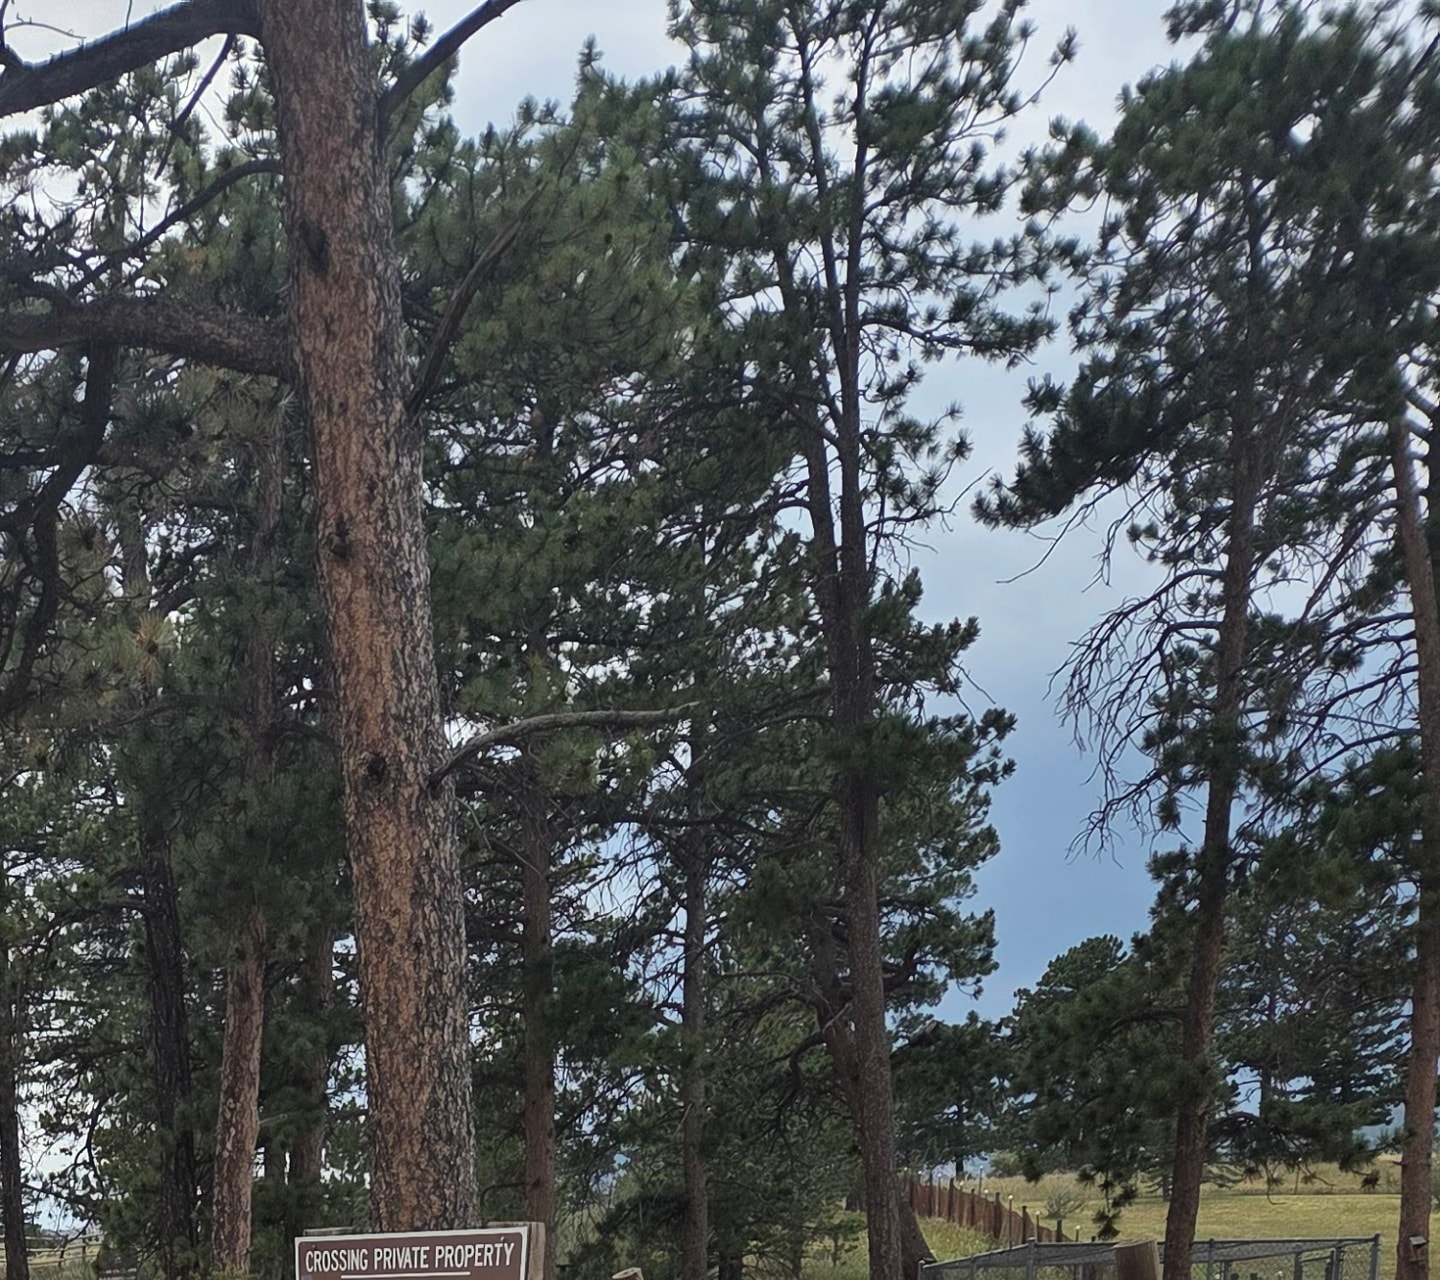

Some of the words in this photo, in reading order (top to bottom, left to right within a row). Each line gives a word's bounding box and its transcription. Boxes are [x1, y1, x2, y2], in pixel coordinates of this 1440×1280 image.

[305, 1248, 368, 1273] CROSSING
[374, 1246, 430, 1270] PRIVATE
[435, 1242, 515, 1268] PROPERTY
